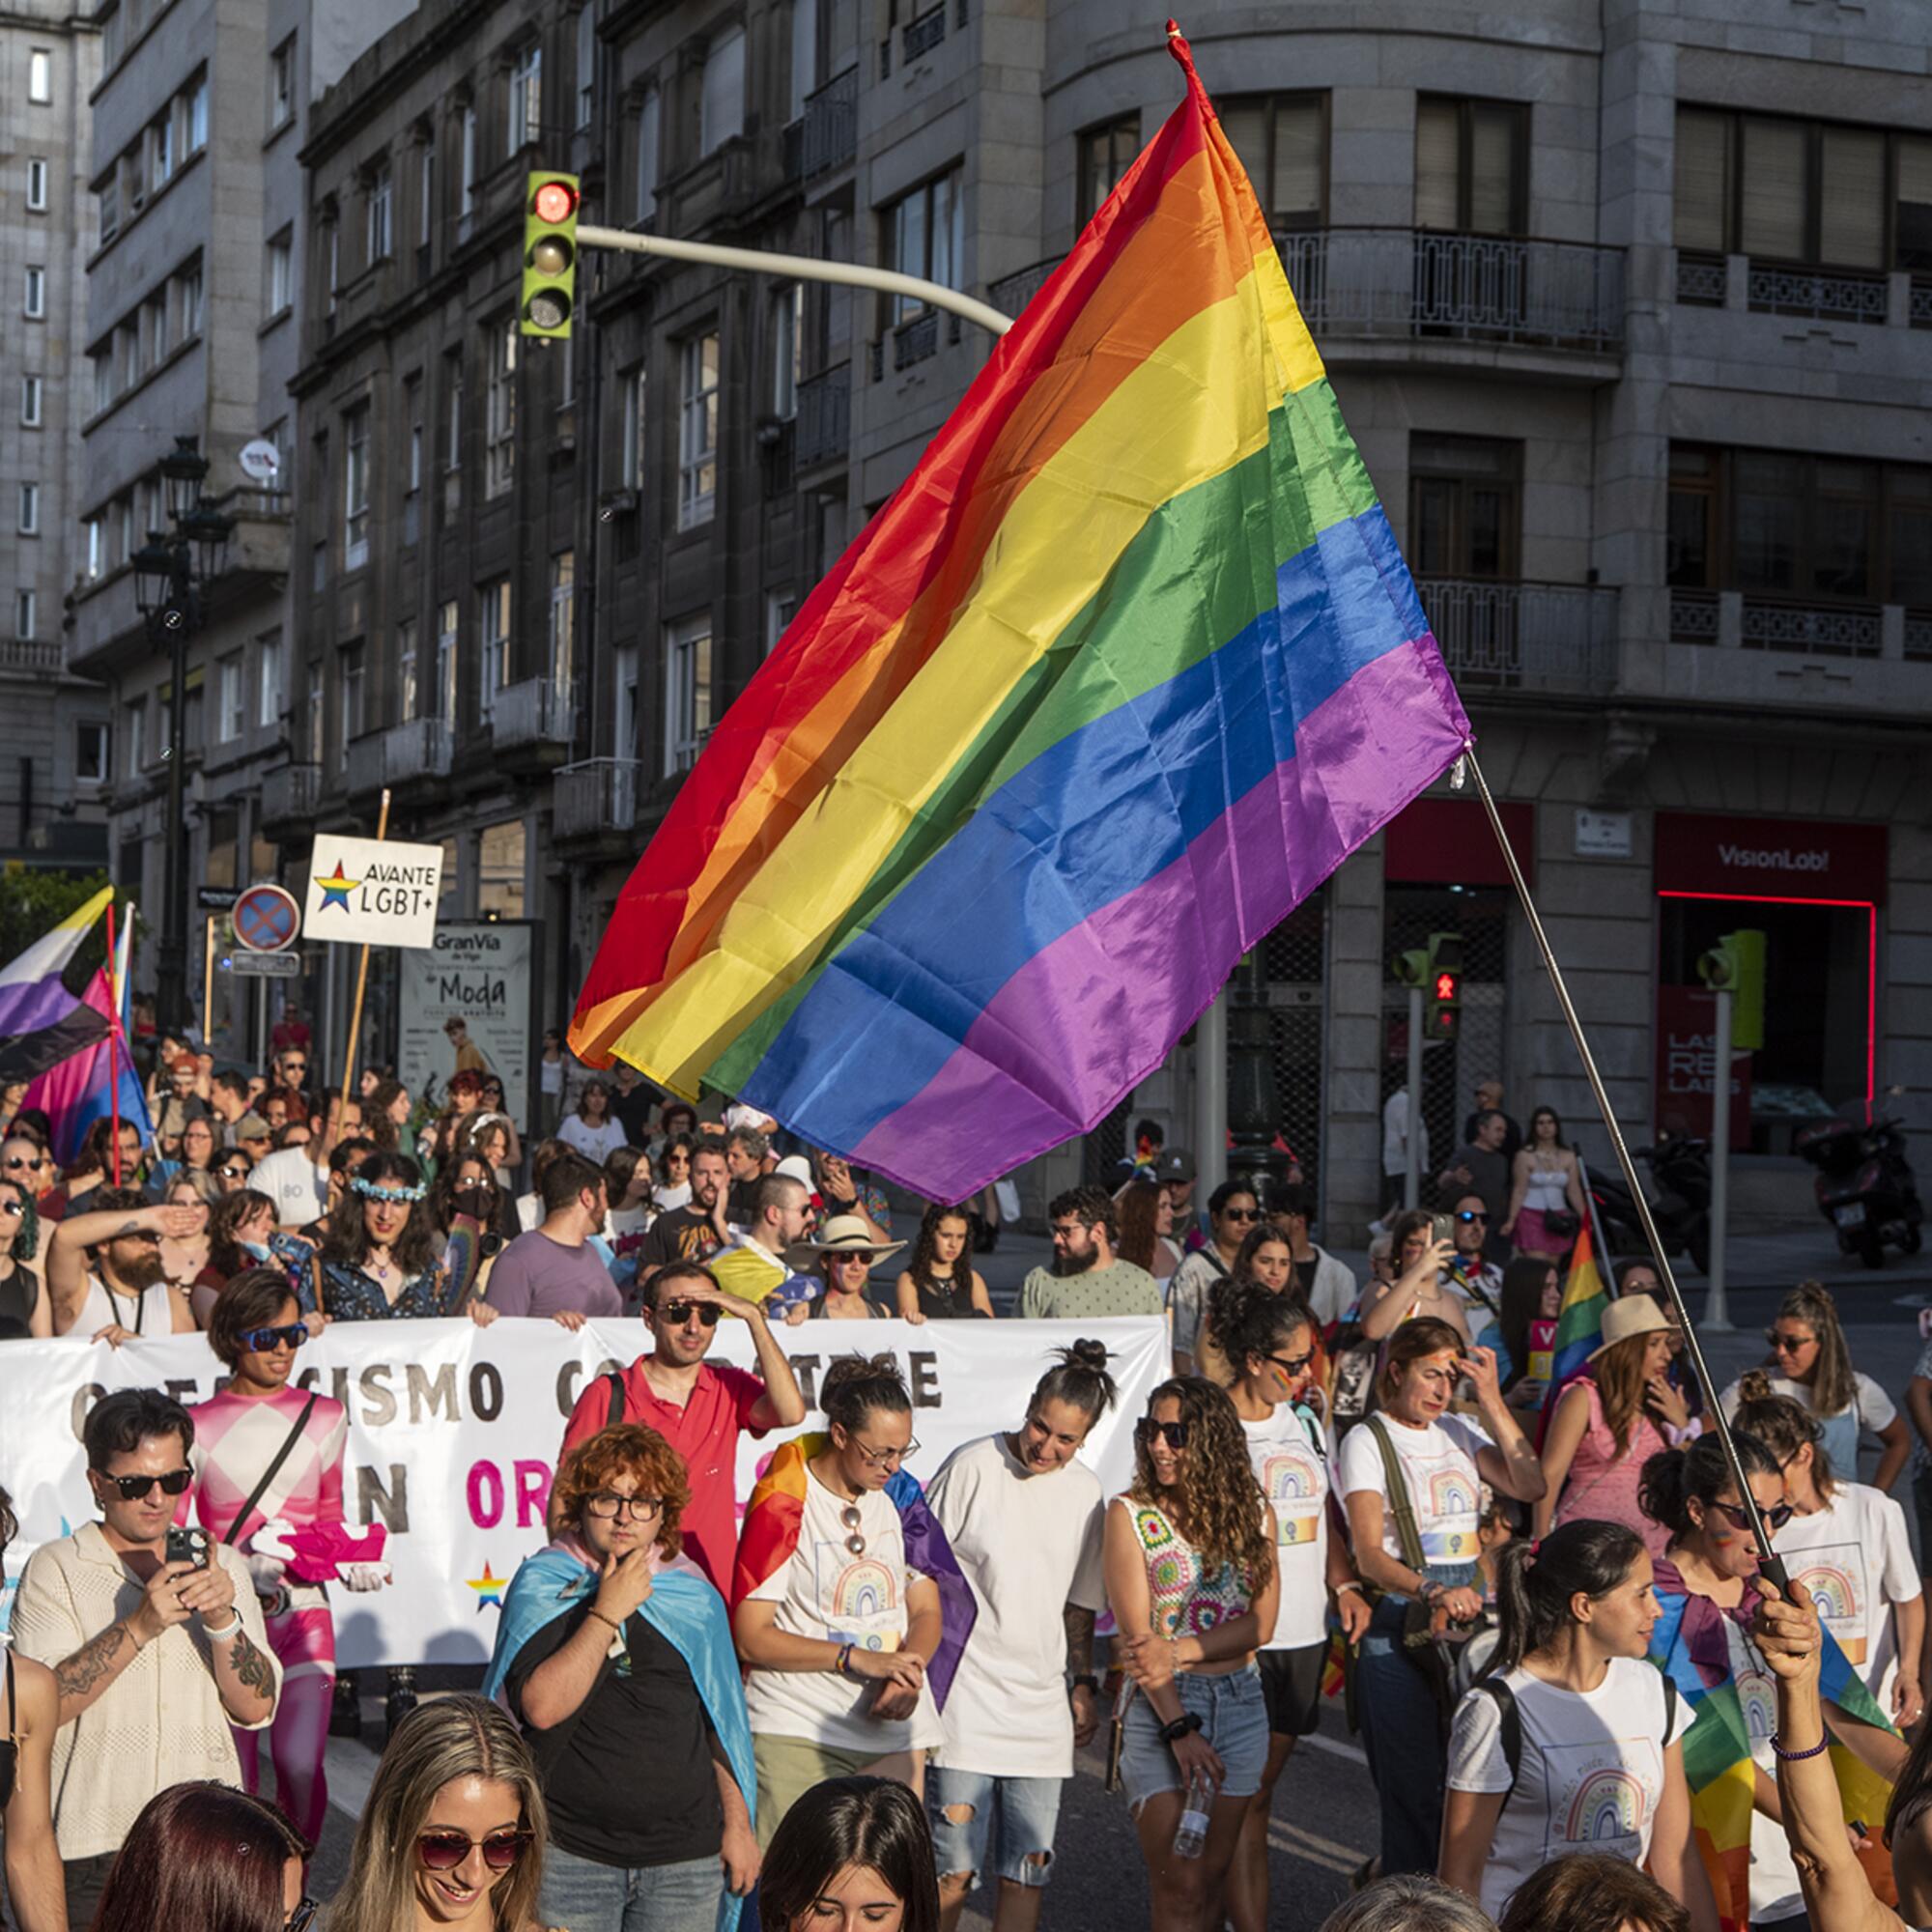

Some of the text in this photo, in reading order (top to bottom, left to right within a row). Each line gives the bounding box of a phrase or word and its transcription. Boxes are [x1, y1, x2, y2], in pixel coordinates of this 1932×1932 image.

[364, 864, 436, 886] AVANTE
[361, 887, 432, 916] LGBT+
[440, 973, 505, 1009] Moda
